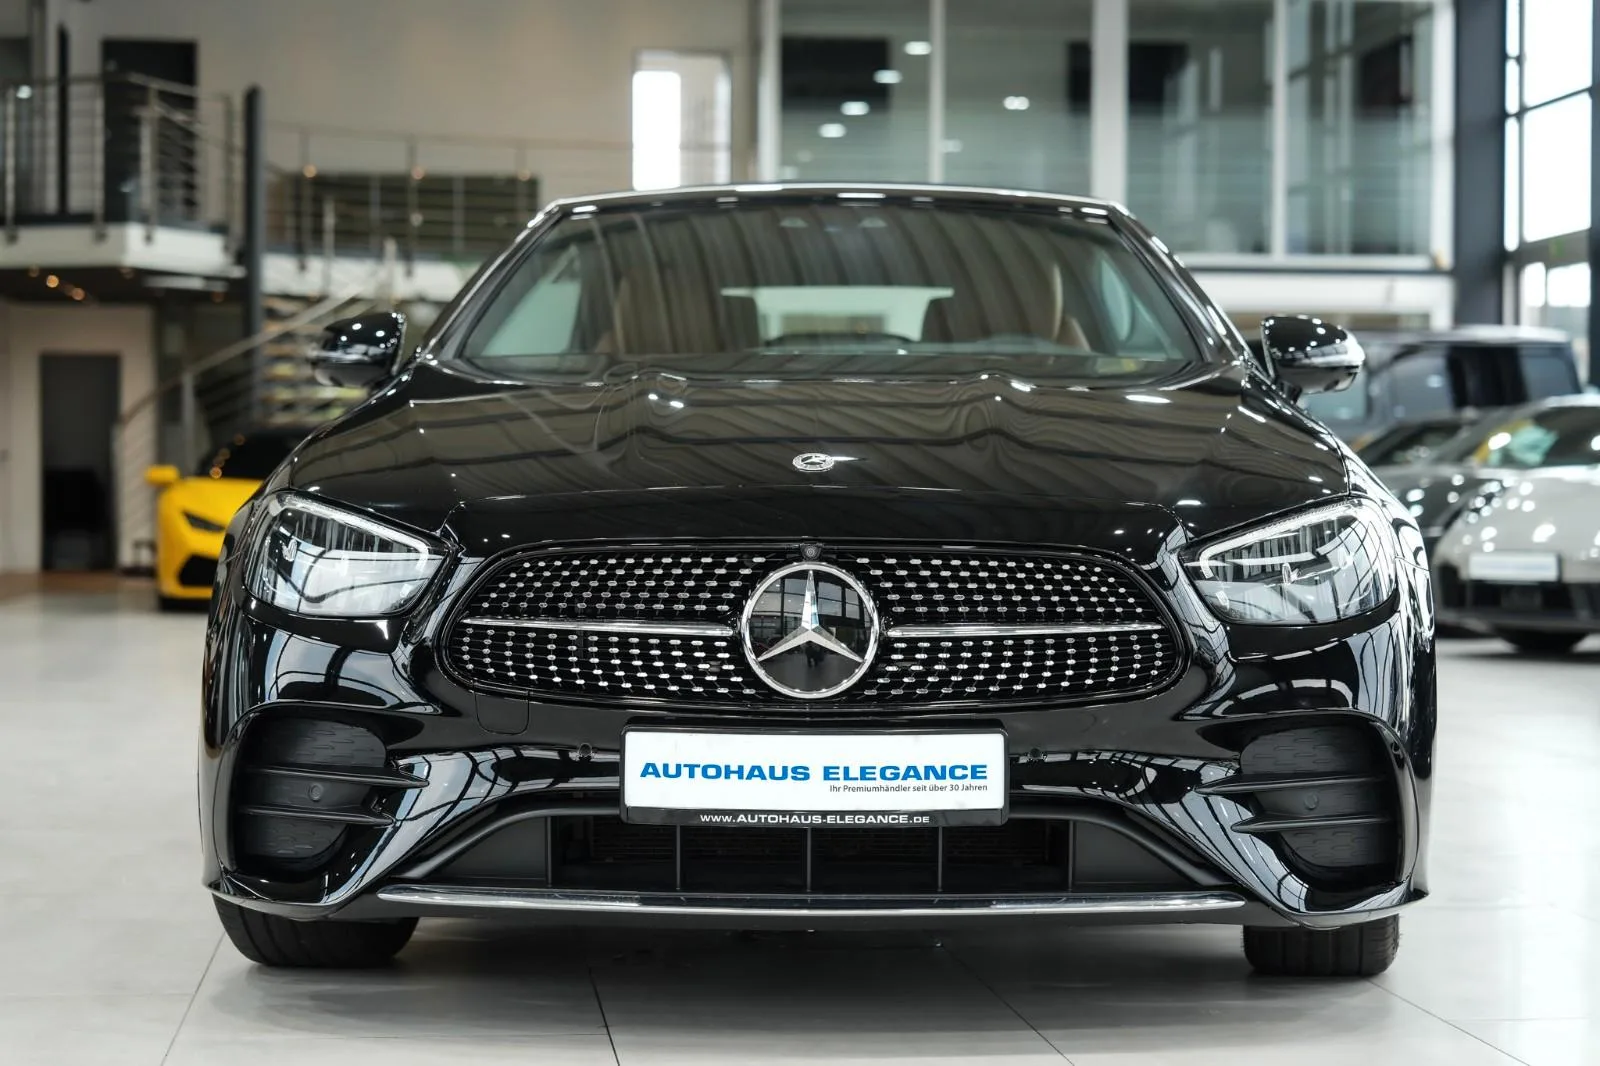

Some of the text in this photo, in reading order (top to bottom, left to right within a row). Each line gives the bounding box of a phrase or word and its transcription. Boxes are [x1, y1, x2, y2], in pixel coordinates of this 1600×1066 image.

[640, 762, 988, 782] AUTOHAUS ELEGANCE
[829, 783, 988, 793] Ihr Premiumhändler seit über 30 Jahren
[700, 814, 930, 824] www.AUTOHAUS-ELEGANCE.DE
